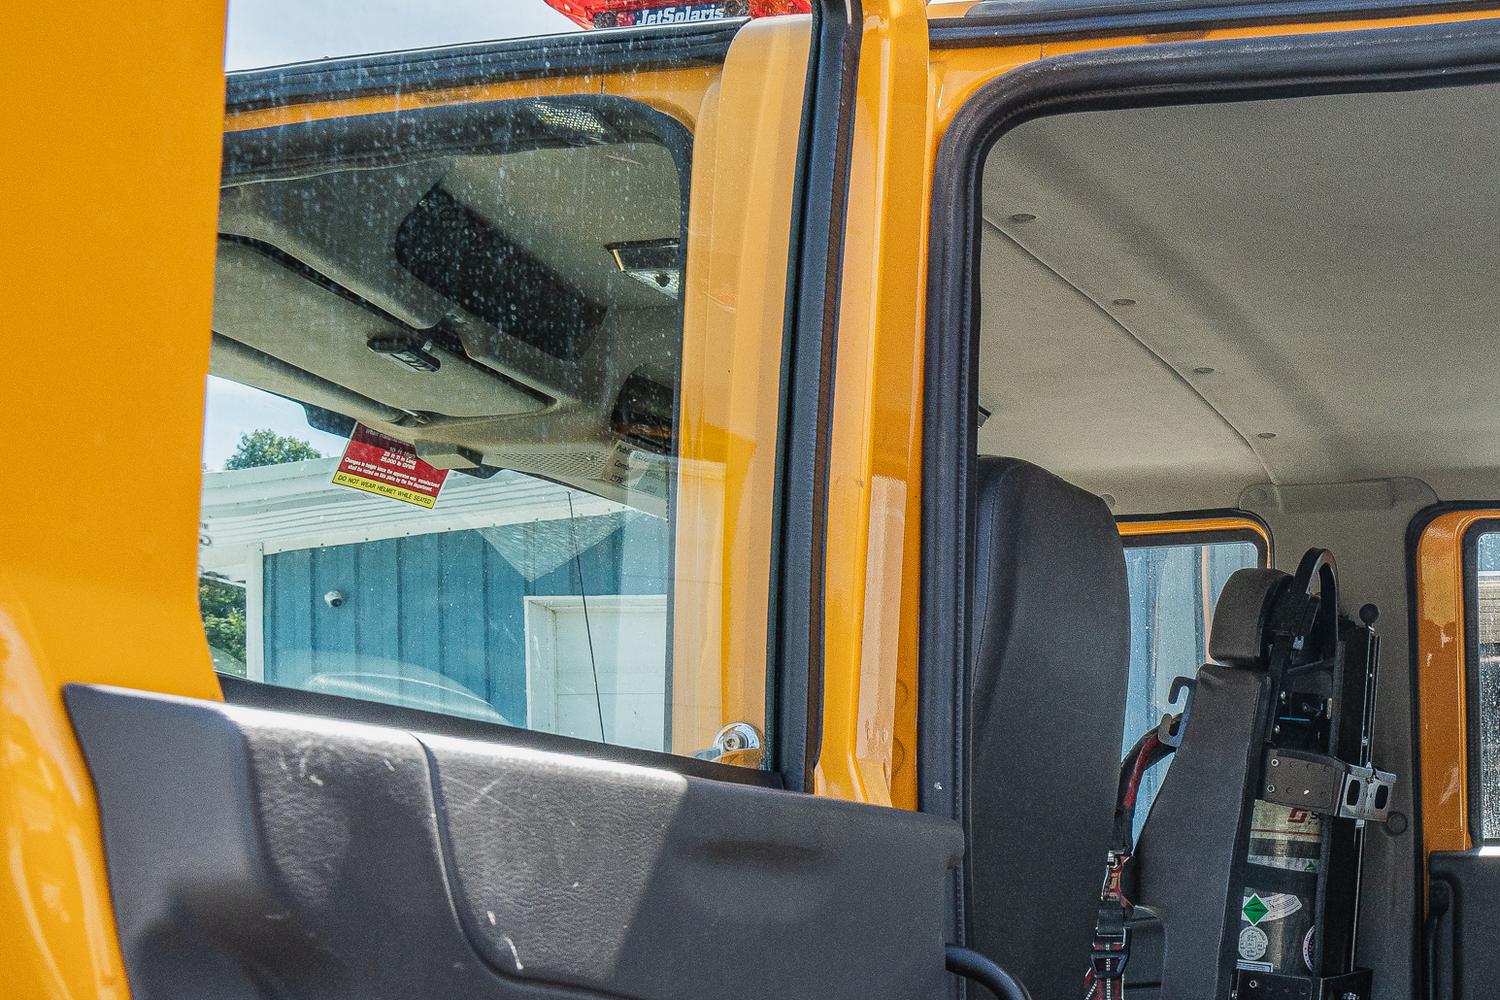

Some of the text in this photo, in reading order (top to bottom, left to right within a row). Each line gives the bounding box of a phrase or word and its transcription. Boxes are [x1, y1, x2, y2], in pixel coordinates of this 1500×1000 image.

[636, 4, 724, 25] JetSolaris
[345, 457, 360, 467] Changes
[365, 463, 377, 471] height
[393, 471, 409, 480] apparatus
[406, 458, 416, 466] Long
[361, 481, 376, 489] WEAR
[377, 486, 396, 494] HELMET
[398, 491, 412, 499] WHILE
[414, 495, 432, 504] SEATED
